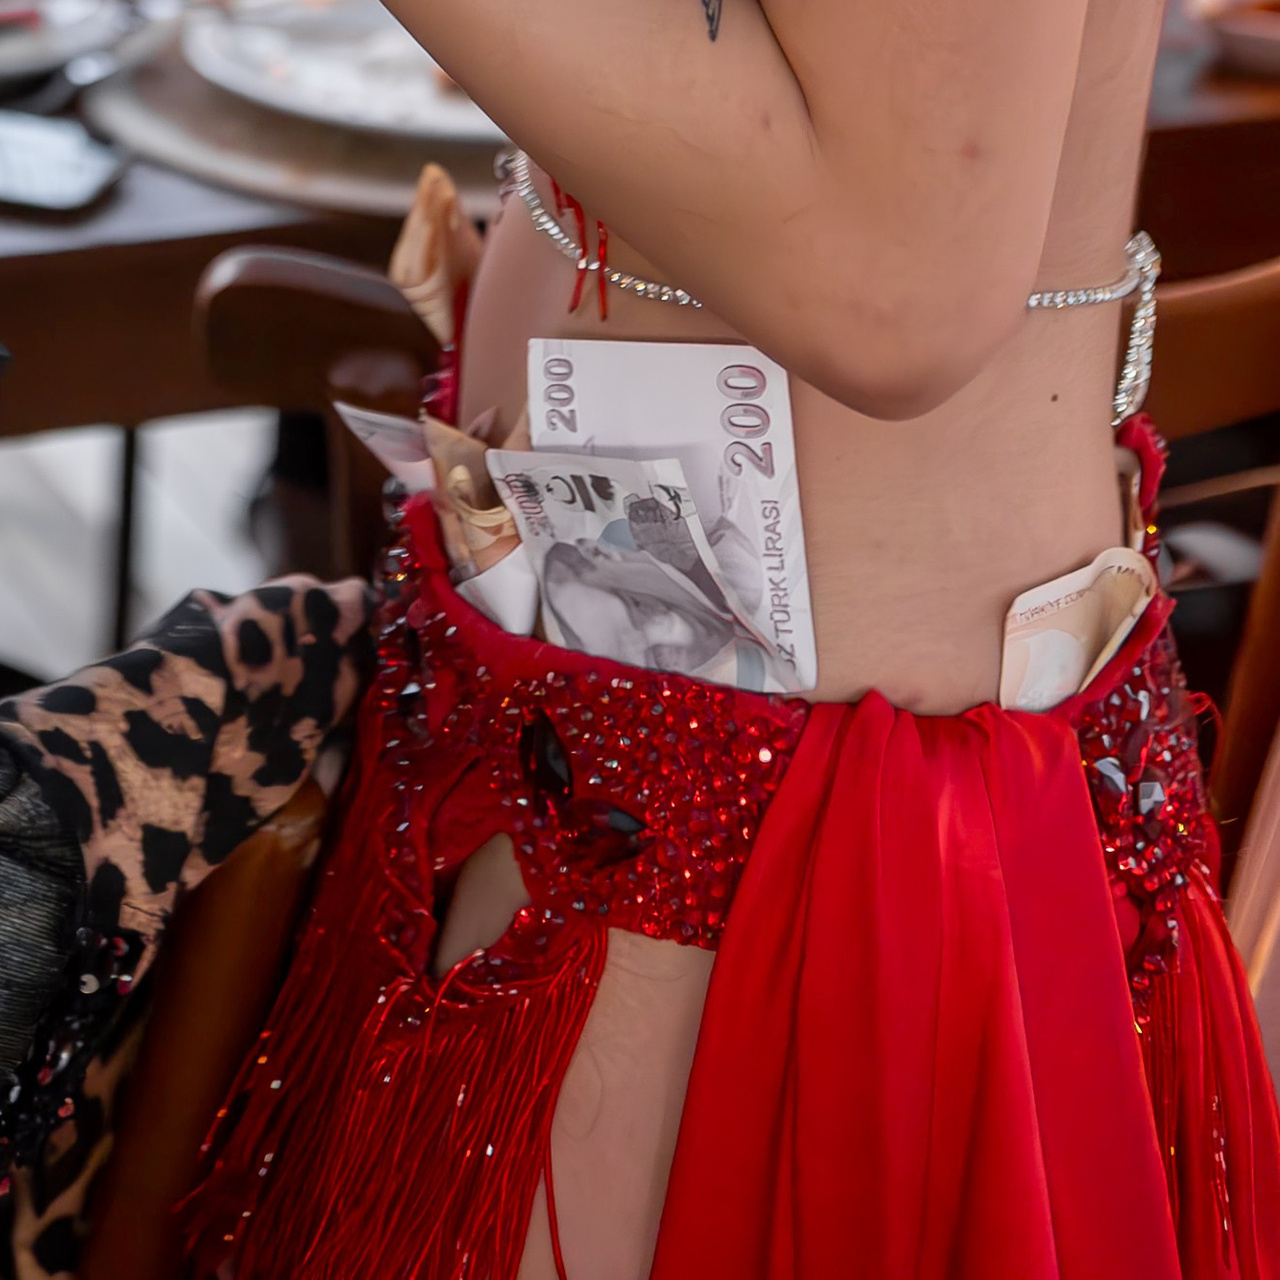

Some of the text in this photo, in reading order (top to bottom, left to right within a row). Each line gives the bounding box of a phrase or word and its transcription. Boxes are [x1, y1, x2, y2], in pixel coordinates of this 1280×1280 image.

[543, 357, 578, 433] 200
[716, 364, 776, 480] 200
[761, 499, 786, 572] LİRASI
[768, 577, 794, 639] TÜRK
